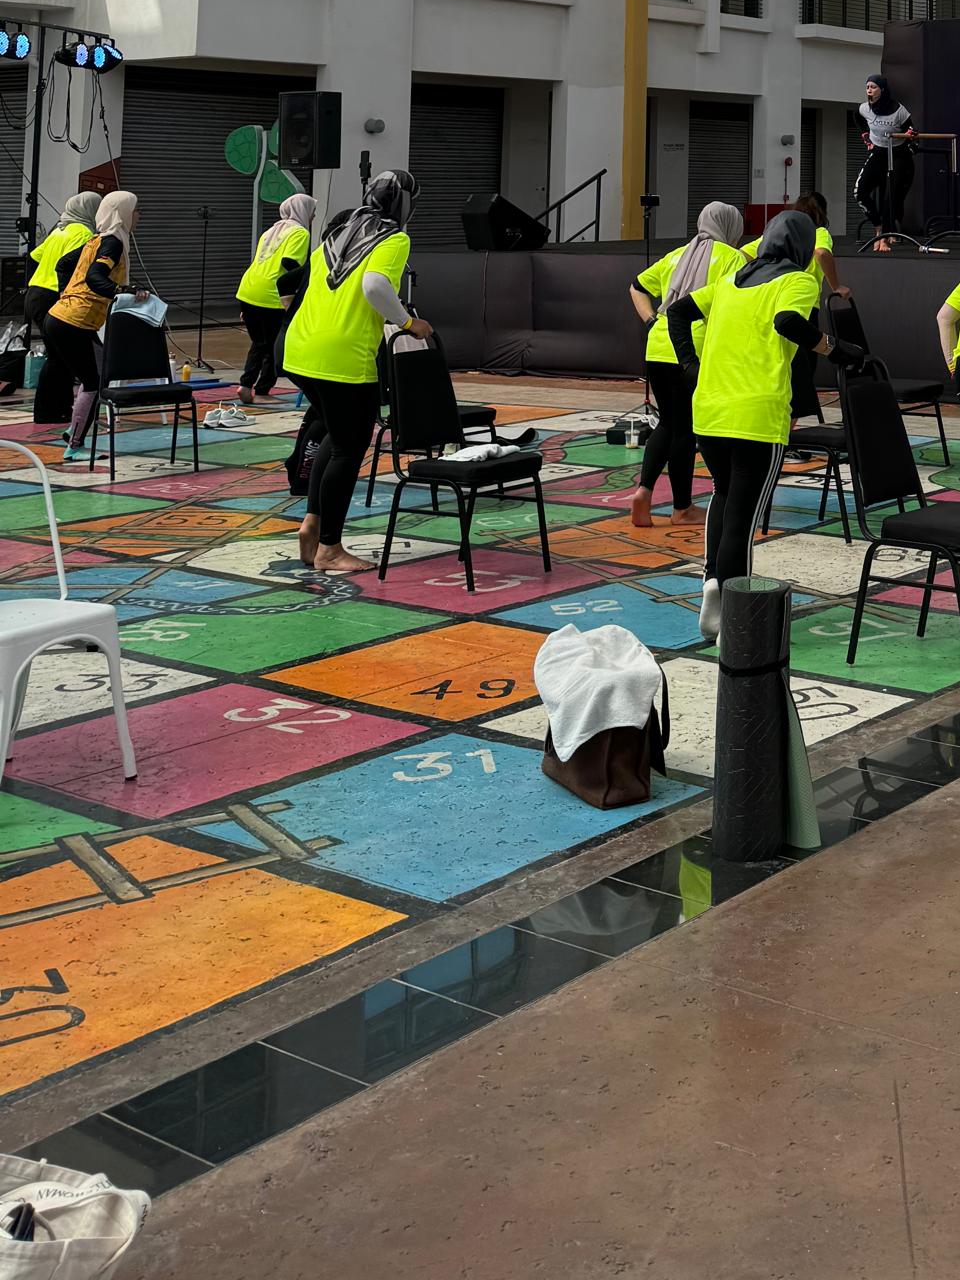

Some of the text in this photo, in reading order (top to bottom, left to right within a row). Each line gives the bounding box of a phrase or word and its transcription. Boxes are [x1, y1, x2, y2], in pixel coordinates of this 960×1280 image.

[156, 514, 228, 526] 55
[551, 599, 624, 617] 52
[410, 678, 517, 701] 49
[222, 697, 353, 735] 32
[392, 748, 497, 783] 31
